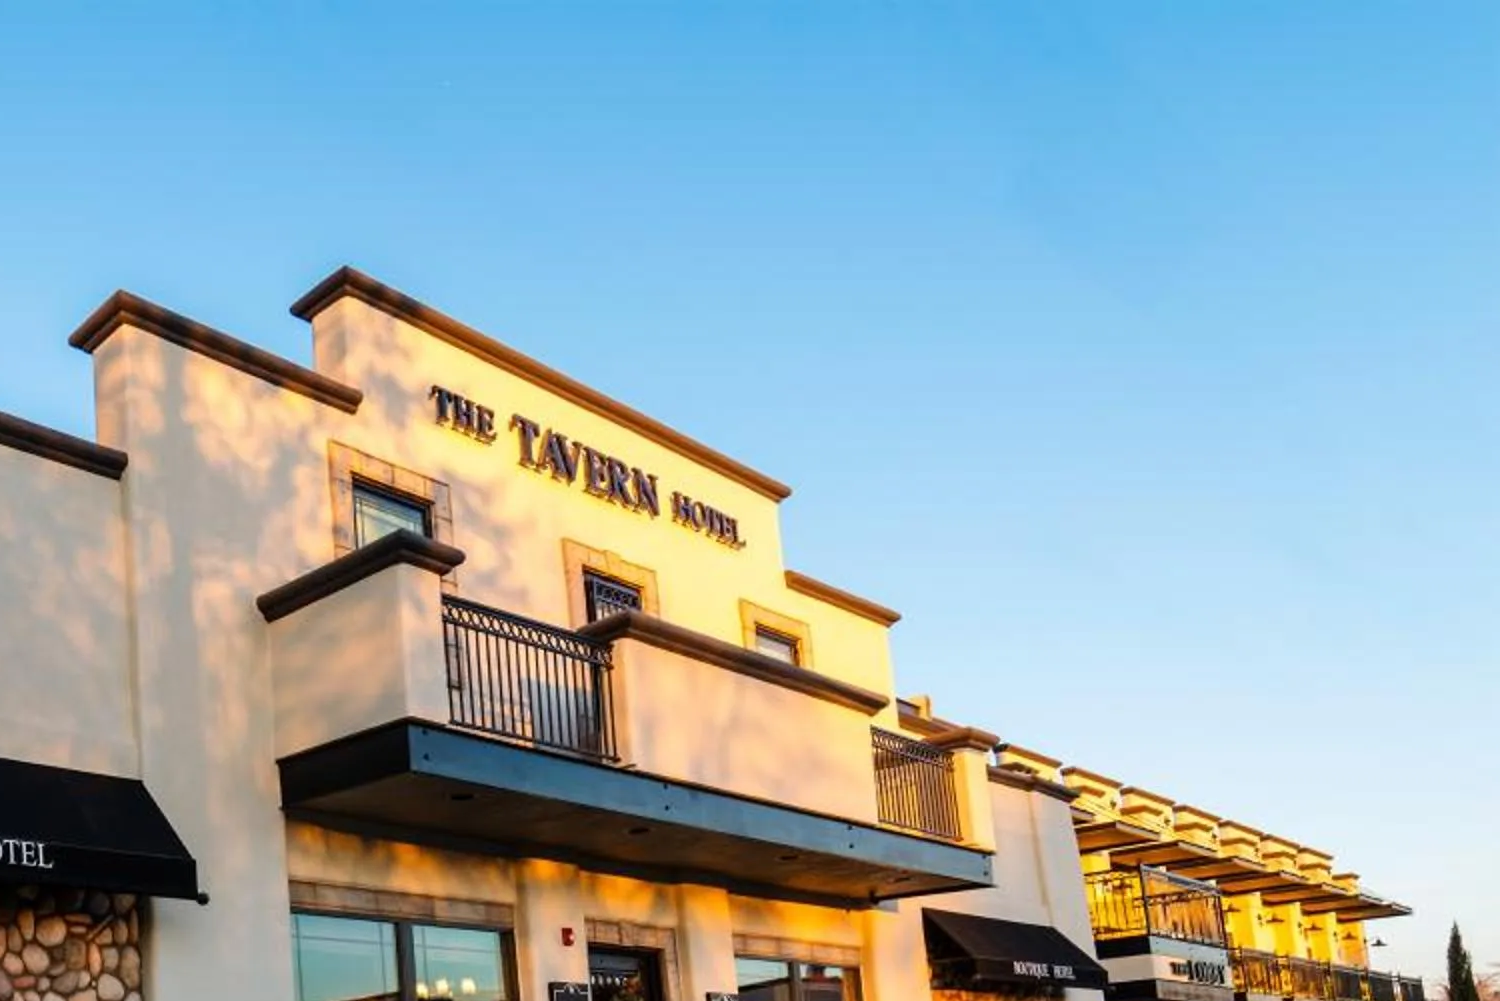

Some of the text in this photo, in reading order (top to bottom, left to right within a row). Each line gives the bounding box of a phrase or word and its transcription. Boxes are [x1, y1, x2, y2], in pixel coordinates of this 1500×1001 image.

[429, 385, 746, 550] THE TAVERN HOTEL
